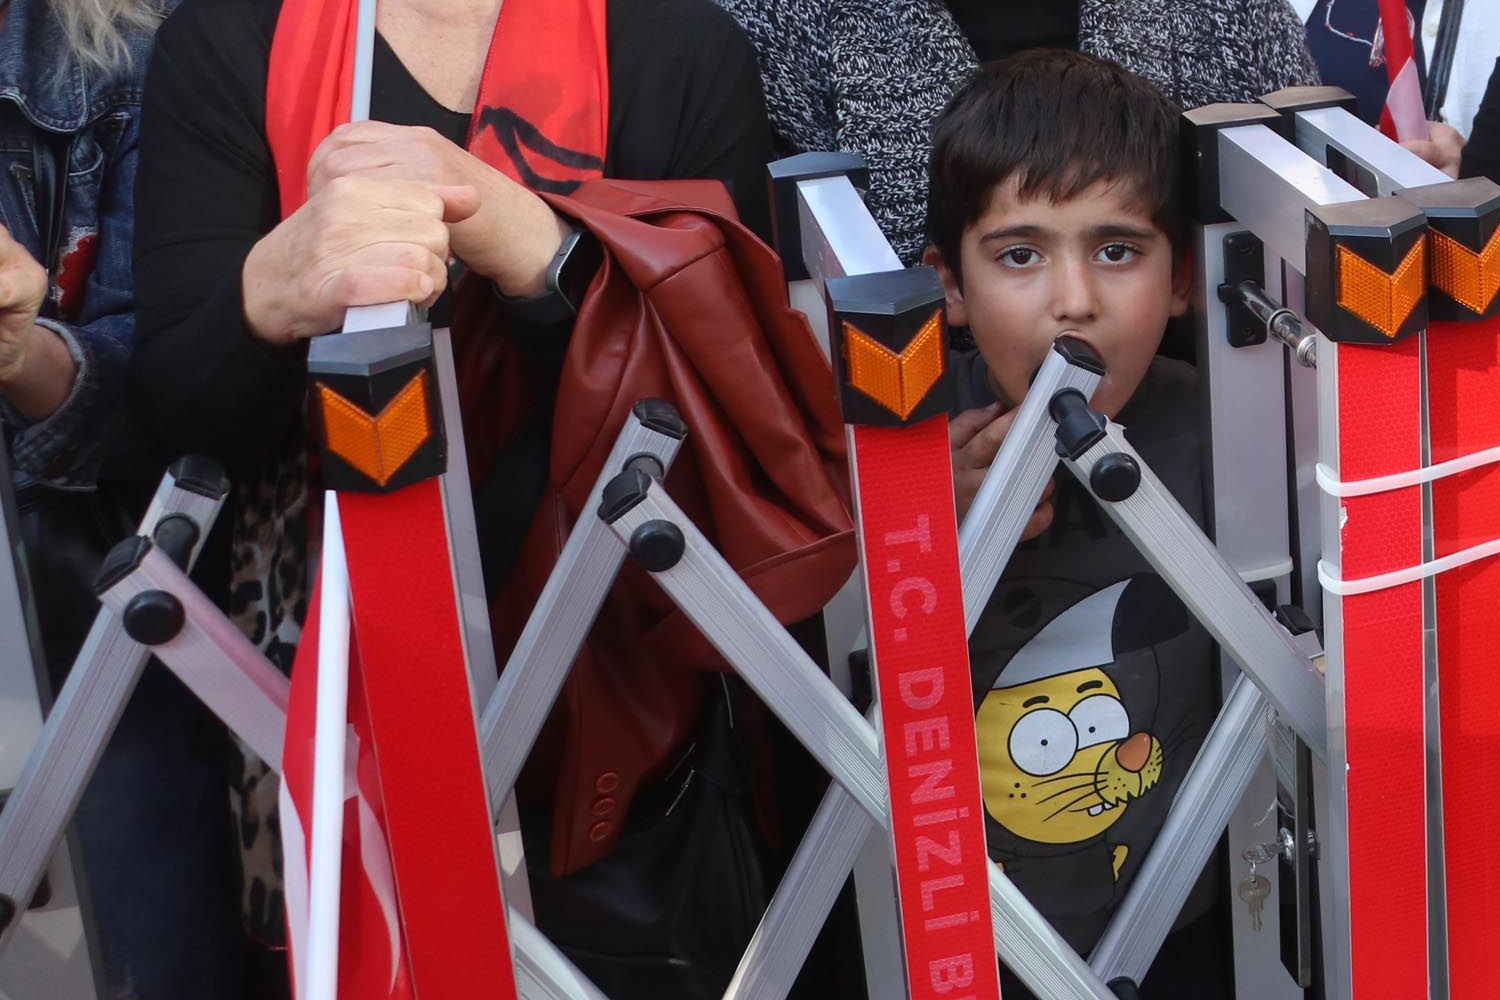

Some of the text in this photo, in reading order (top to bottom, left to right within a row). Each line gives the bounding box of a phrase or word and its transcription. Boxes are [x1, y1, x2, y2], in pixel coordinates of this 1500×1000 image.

[885, 514, 980, 1000] T.C. DENİZLİ B
